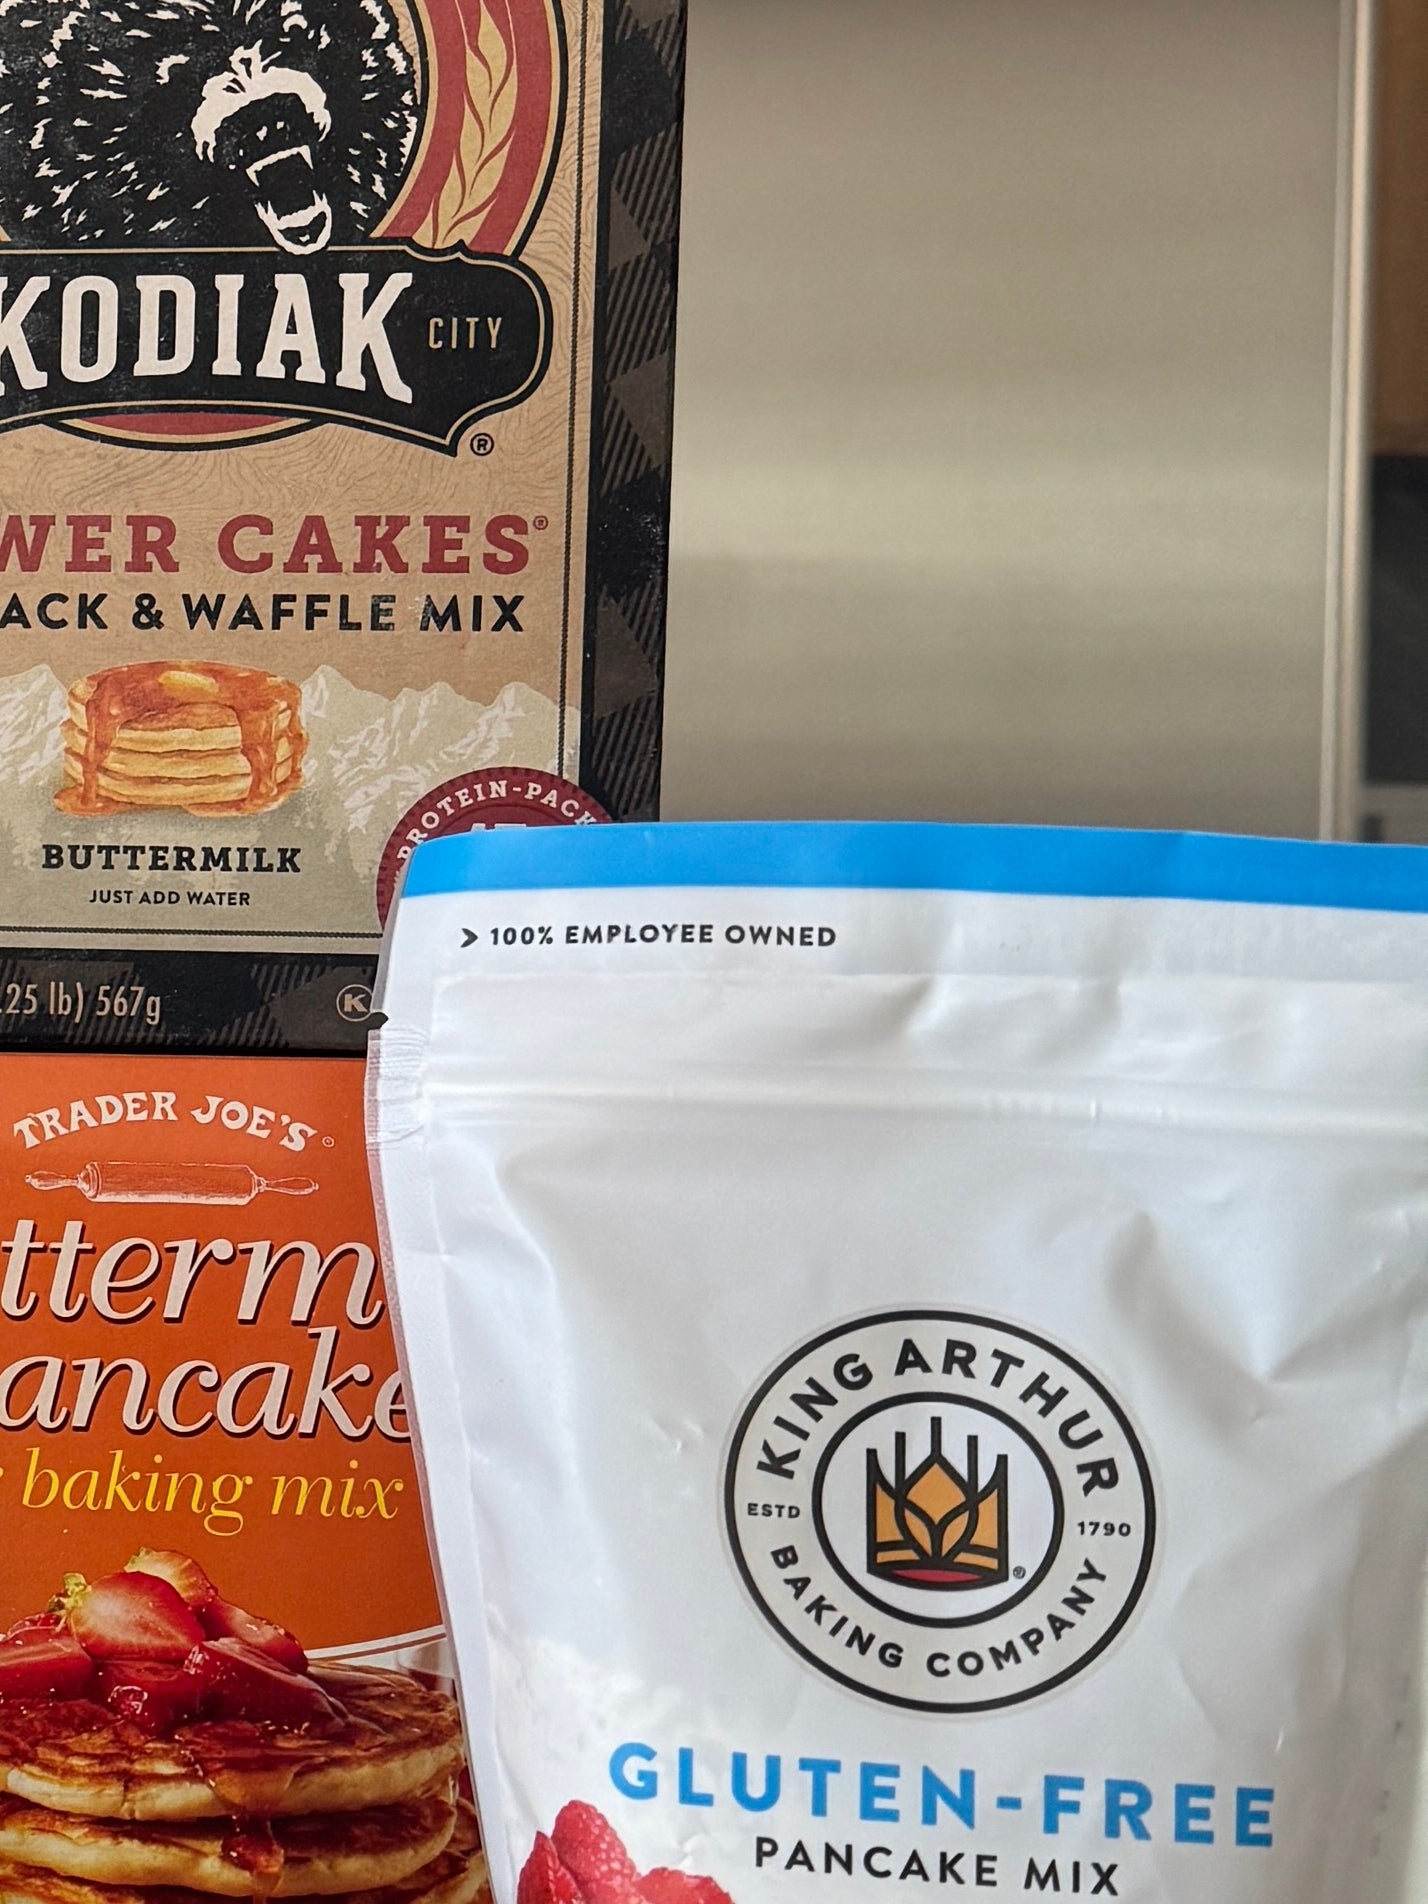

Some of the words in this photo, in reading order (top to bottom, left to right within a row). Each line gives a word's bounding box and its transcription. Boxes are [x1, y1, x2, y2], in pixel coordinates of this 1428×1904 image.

[427, 316, 504, 351] CITY
[218, 514, 532, 576] CAKES
[131, 592, 164, 630] &
[184, 594, 396, 633] WAFFLE
[419, 594, 525, 634] MIX
[41, 843, 303, 874] BUTTERMILK
[489, 925, 555, 948] 100%
[564, 922, 715, 947] EMPLOYEE
[724, 924, 837, 948] OWNED
[13, 1092, 181, 1150] TRADER
[191, 1092, 319, 1153] JOE'S
[756, 1350, 874, 1481] KING
[894, 1337, 1120, 1499] ARTHUR
[24, 1450, 254, 1536] baking
[270, 1461, 405, 1520] mix
[746, 1502, 801, 1521] ESTD
[1076, 1519, 1133, 1538] 1790
[769, 1542, 905, 1671] BAKING
[925, 1557, 1109, 1679] COMPANY
[609, 1742, 1276, 1848] GLUTEN-FREE
[754, 1835, 999, 1889] PANCAKE
[1023, 1856, 1121, 1897] MIX
